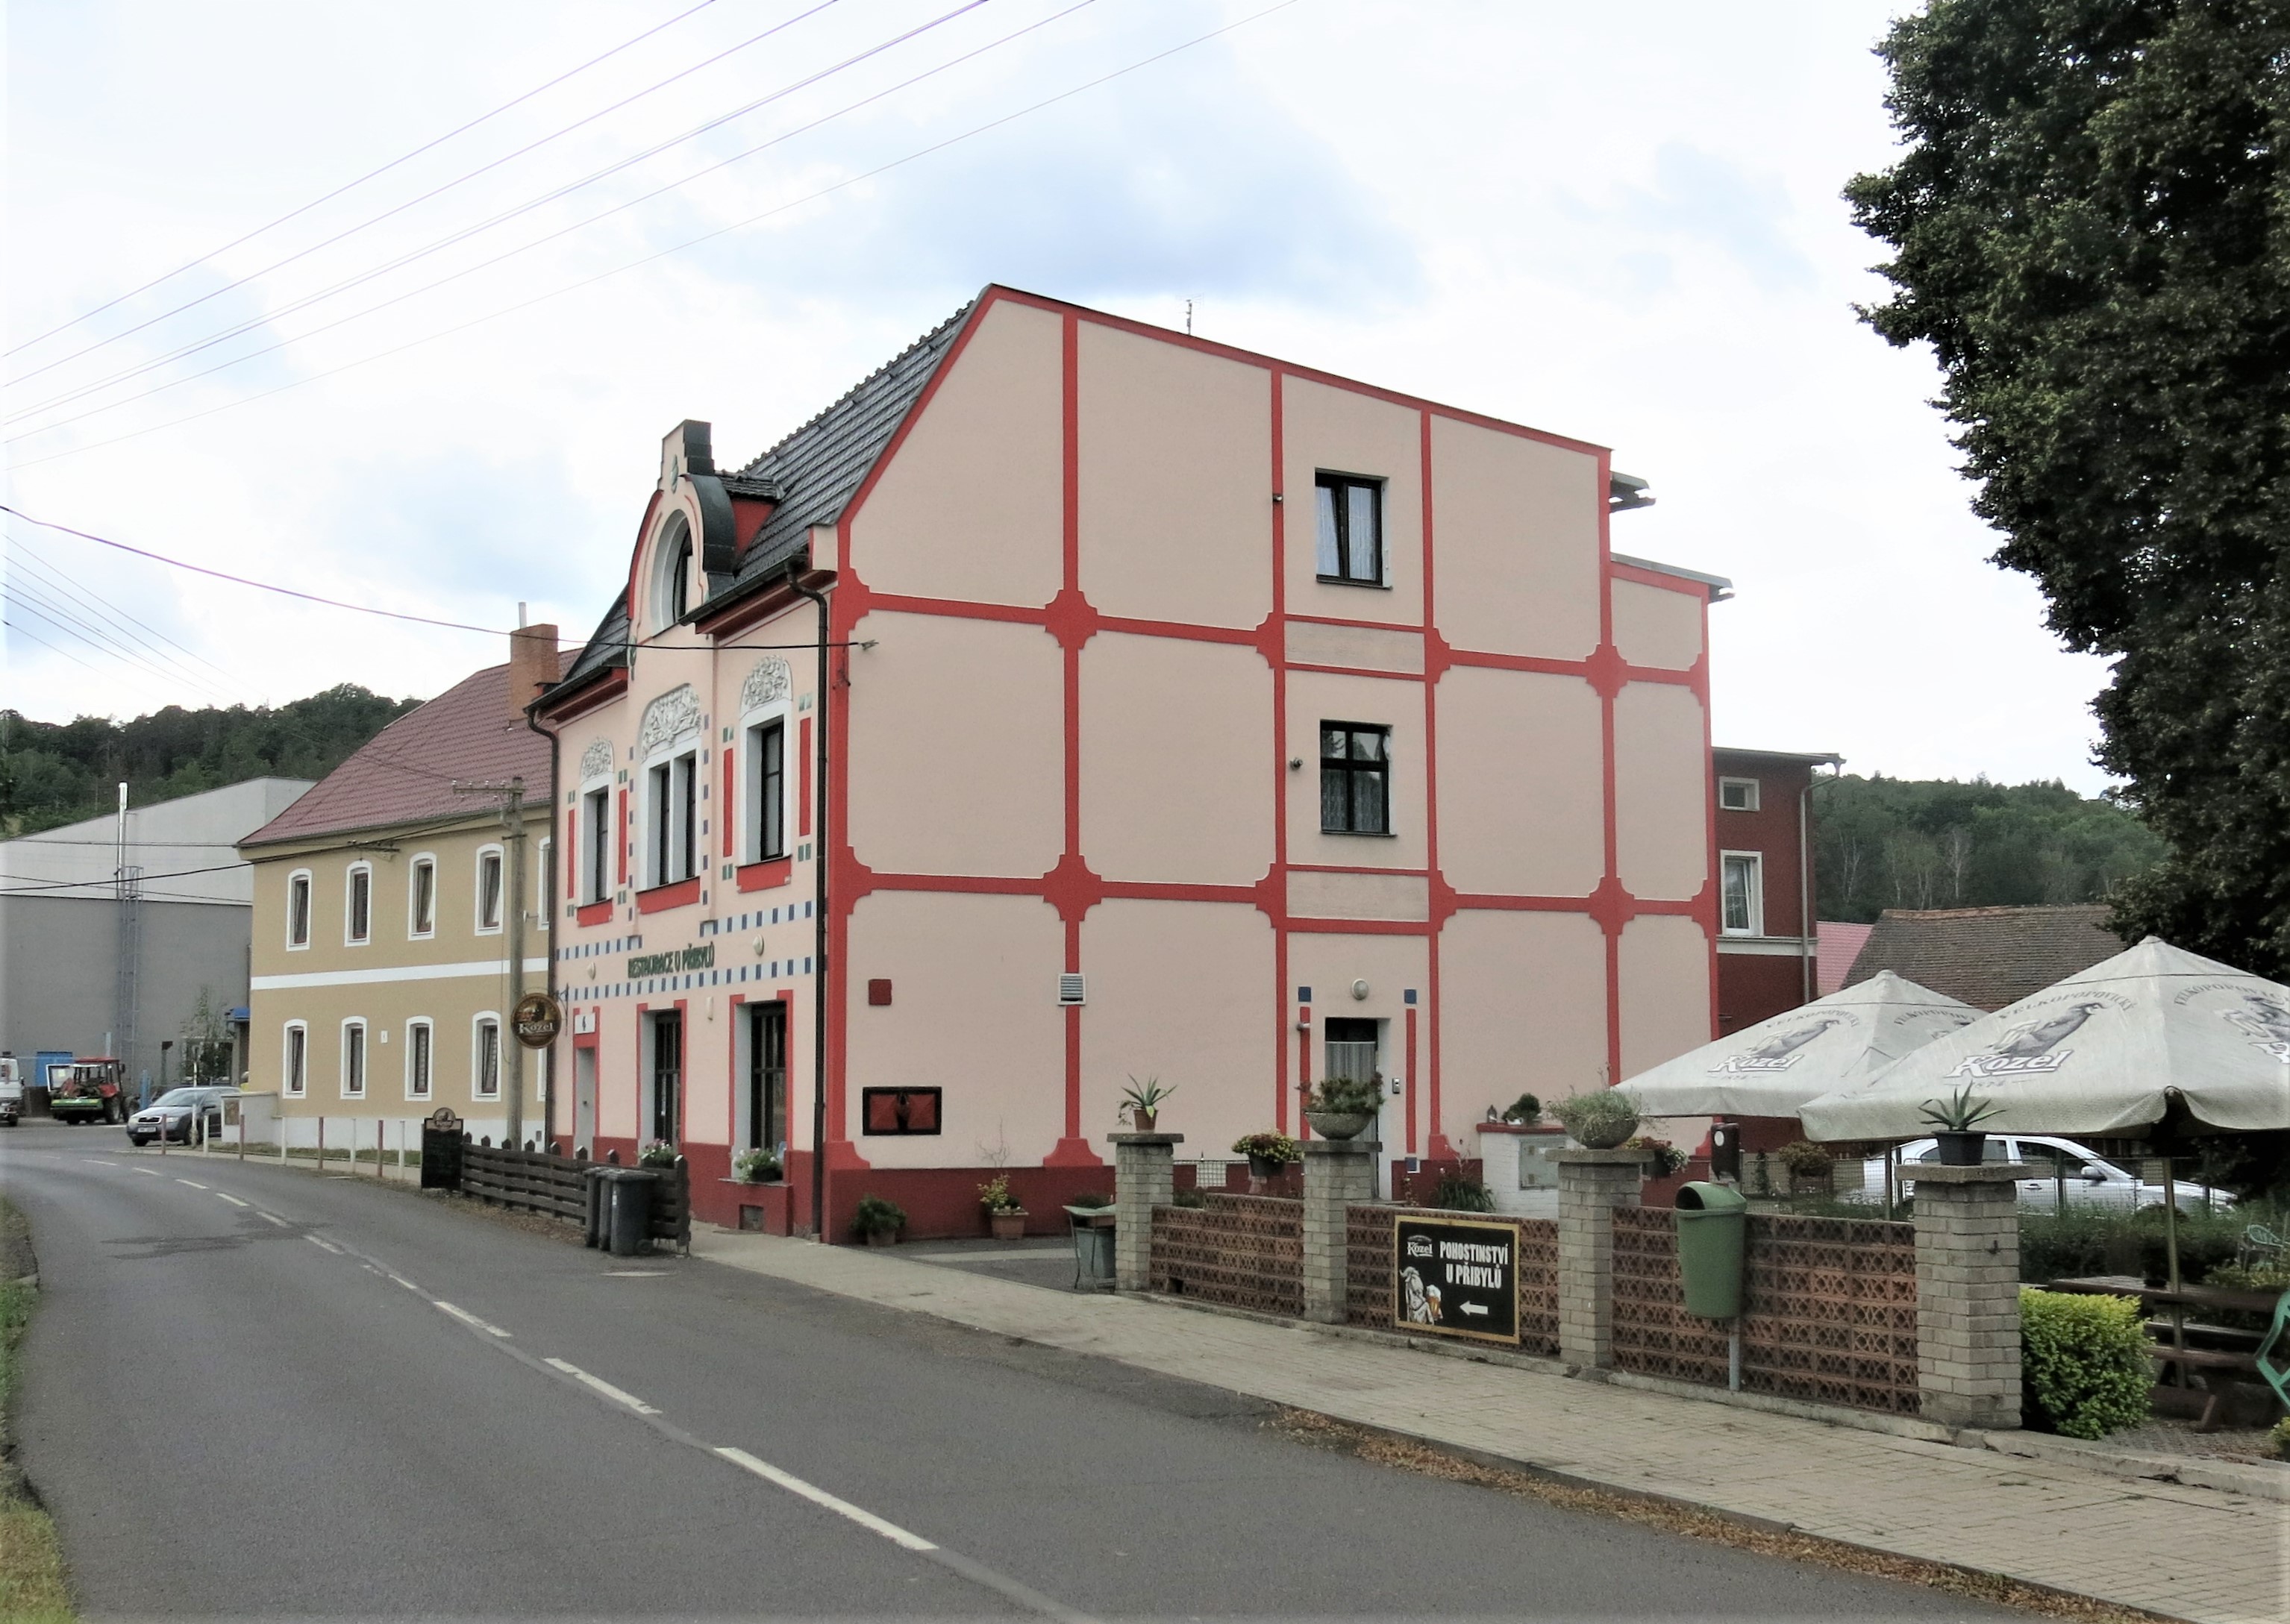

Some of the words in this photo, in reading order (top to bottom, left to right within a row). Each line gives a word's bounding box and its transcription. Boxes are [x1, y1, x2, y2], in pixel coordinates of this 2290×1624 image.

[675, 950, 681, 972] U
[519, 1023, 554, 1035] Kozel
[1707, 1054, 1805, 1073] Kozel
[1943, 1049, 2074, 1078] Kozel
[1407, 1241, 1433, 1257] Kozel
[1439, 1241, 1508, 1265] POHOSTINSTVÍ
[1445, 1264, 1454, 1283] U
[1455, 1261, 1502, 1289] PŘIBYLŮ
